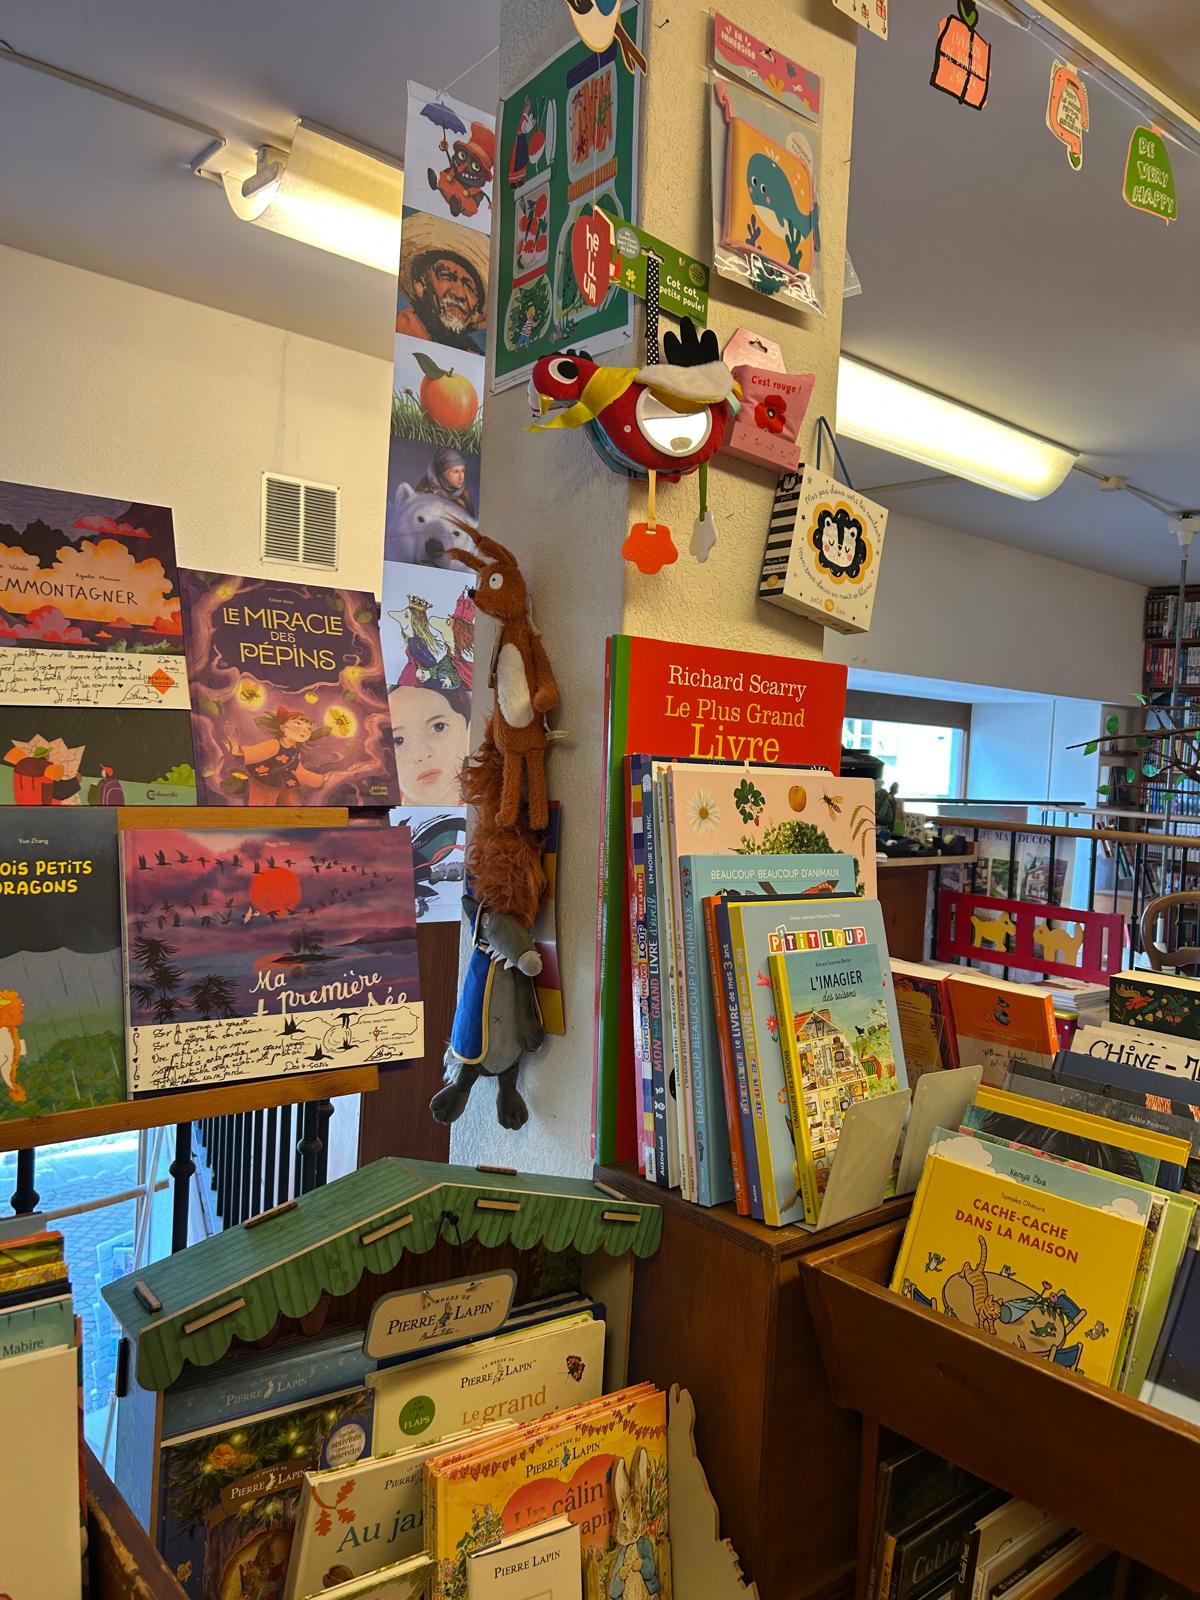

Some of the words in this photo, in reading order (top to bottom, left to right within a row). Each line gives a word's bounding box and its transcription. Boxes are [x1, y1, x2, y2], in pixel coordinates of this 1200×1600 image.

[1138, 136, 1155, 158] BE
[1136, 160, 1168, 188] VERY
[1132, 186, 1175, 213] HAPPY
[659, 285, 681, 301] petite
[682, 297, 705, 313] poule!
[666, 275, 681, 290] Cot
[683, 286, 699, 300] cot,
[751, 375, 771, 388] C'est
[773, 382, 797, 395] rouge
[0, 575, 138, 606] MMONTAGNER
[223, 607, 241, 625] LE
[244, 606, 344, 637] MIRACLE
[270, 631, 296, 643] DES
[668, 664, 744, 692] Richard
[749, 674, 807, 702] Scarry
[665, 695, 690, 718] Le
[696, 698, 741, 722] Plus
[747, 703, 805, 727] Grand
[690, 722, 781, 763] Livre
[645, 813, 653, 839] BLANC
[1017, 832, 1051, 846] DUCOS
[647, 840, 653, 850] ET
[636, 879, 644, 894] FÊTE
[648, 874, 655, 884] EN
[711, 869, 755, 880] BEAUCOUP
[757, 869, 799, 880] BEAUCOUP
[801, 868, 840, 879] D'ANIMAUX
[637, 894, 644, 902] LA
[637, 902, 645, 921] C'EST
[637, 923, 648, 960] LOUP
[684, 905, 698, 975] D'ANIMAUX
[721, 944, 731, 959] ans
[823, 928, 864, 947] LOUP
[648, 939, 660, 975] LIVRE
[723, 960, 733, 970] 3
[249, 971, 287, 993] Ma
[277, 969, 383, 1014] première
[639, 964, 649, 999] trouve
[726, 972, 734, 990] mes
[739, 976, 748, 994] mes
[810, 970, 863, 991] L'IMAGIER
[649, 978, 663, 1019] GRAND
[728, 991, 735, 1002] de
[822, 990, 834, 1002] des
[834, 989, 857, 1001] saisons
[688, 977, 701, 1049] BEAUCOUP
[640, 1015, 651, 1062] Cherche
[653, 1039, 664, 1073] MON
[784, 1049, 794, 1079] SAISONS
[693, 1051, 704, 1124] BEAUCOUP
[791, 1093, 800, 1129] L'IMAGIER
[1010, 1168, 1031, 1182] Kenya
[972, 1197, 1070, 1241] CACHE-CACHE
[955, 1208, 993, 1233] DANS
[996, 1223, 1014, 1240] LA
[1017, 1232, 1080, 1264] MAISON
[386, 1314, 437, 1336] PIERRE
[453, 1302, 494, 1321] LAPIN
[2, 1337, 45, 1357] Mabire
[460, 1372, 494, 1389] PIERRE
[504, 1361, 533, 1377] LAPIN
[226, 1390, 263, 1407] PIERRE
[277, 1376, 307, 1393] LAPIN
[461, 1409, 480, 1426] Le
[483, 1385, 547, 1426] grand
[403, 1414, 431, 1430] FLAPS
[525, 1459, 561, 1478] PIERRE
[571, 1443, 600, 1461] LAPIN
[230, 1482, 265, 1499] PIERRE
[277, 1468, 306, 1486] LAPIN
[384, 1473, 416, 1491] PIERRE
[553, 1481, 604, 1516] câlin
[581, 1506, 617, 1536] apin
[336, 1523, 382, 1554] Au
[493, 1559, 530, 1579] PIERRE
[532, 1550, 561, 1569] LAPIN
